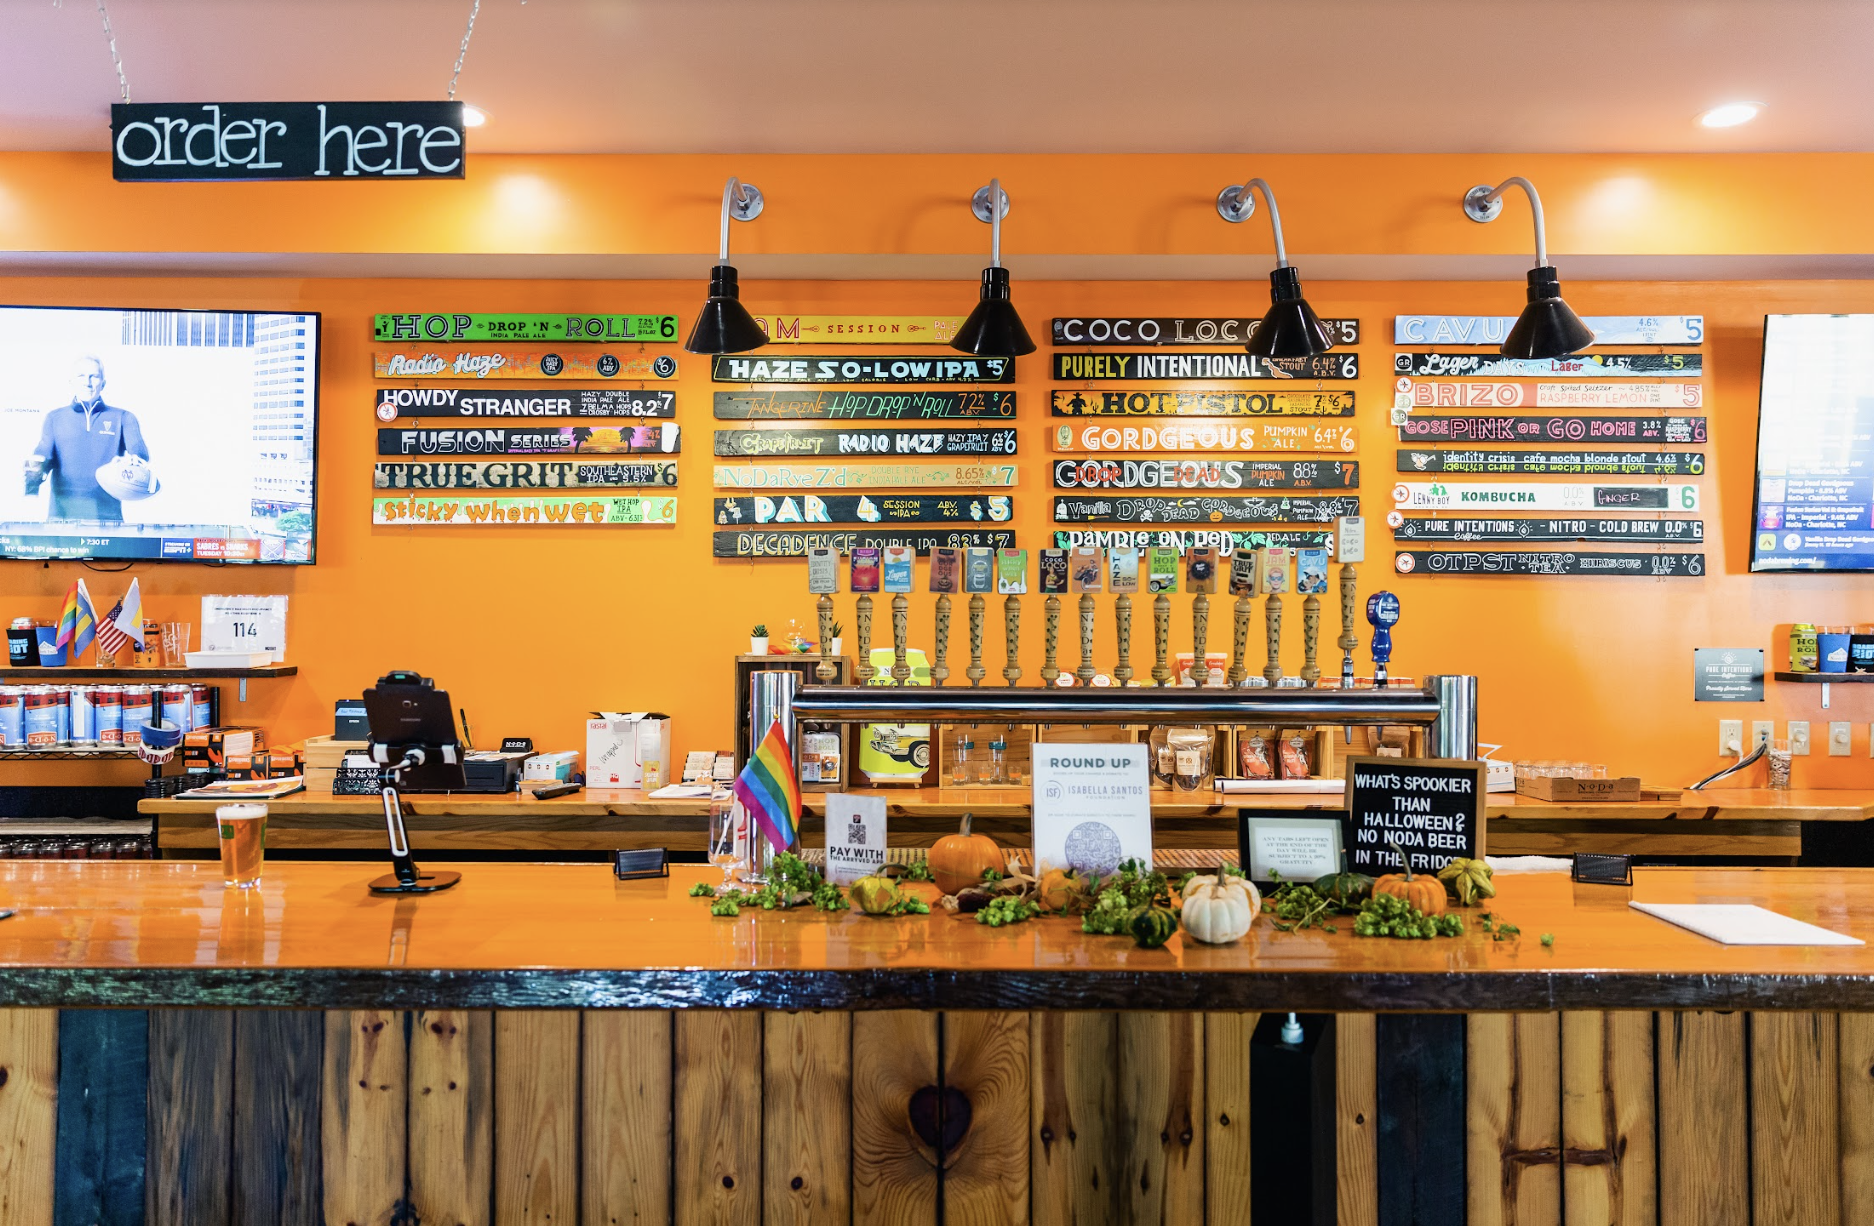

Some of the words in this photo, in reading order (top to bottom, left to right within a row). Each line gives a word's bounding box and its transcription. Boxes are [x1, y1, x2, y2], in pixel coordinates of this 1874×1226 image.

[116, 104, 287, 169] order
[314, 104, 461, 176] here
[392, 315, 473, 339] HOP
[488, 321, 527, 332] DROP
[565, 317, 636, 338] ROLL
[827, 324, 901, 334] SESSION
[933, 320, 958, 330] PALE
[1638, 317, 1659, 327] 4.6%
[1063, 319, 1161, 342] COCO
[1402, 317, 1504, 343] CAVU
[387, 352, 448, 376] Radio
[452, 351, 506, 378] Haze
[728, 359, 808, 379] HAZE
[935, 360, 980, 378] IPA
[1061, 355, 1131, 378] PURELY
[1137, 355, 1262, 378] INTENTIONAL
[1279, 361, 1306, 371] STOUT
[1418, 353, 1480, 375] Lager
[1482, 360, 1525, 376] DAYS
[1551, 359, 1584, 372] Lager
[1414, 383, 1519, 406] BRIZO
[1540, 392, 1602, 404] RASPBERRY
[1605, 393, 1647, 404] LEMON
[383, 389, 459, 406] HOWDY
[459, 398, 572, 416] STRANGER
[732, 390, 828, 419] TANGERINE
[1101, 392, 1173, 414] HOT
[1175, 392, 1284, 414] PISTOL
[1263, 425, 1308, 437] PUMPKIN
[1405, 420, 1449, 435] GOSE
[1450, 418, 1515, 440] PINK
[1517, 422, 1540, 435] OR
[1546, 417, 1586, 440] GO
[1590, 420, 1637, 436] HOME
[1642, 421, 1662, 430] 3.8%
[401, 430, 506, 454] FUSION
[510, 434, 573, 448] SERIES
[838, 434, 891, 453] RADIO
[895, 434, 946, 453] HAZE
[947, 433, 965, 443] HAZY
[1081, 426, 1256, 451] GORDGEOUS
[1273, 438, 1296, 449] ALE
[946, 442, 989, 452] GRAPEFRUIT
[1442, 450, 1485, 463] identity
[1487, 451, 1516, 463] crisis
[1523, 452, 1547, 463] cafe
[1549, 452, 1581, 464] mocha
[1583, 453, 1620, 464] blonde
[1621, 453, 1647, 464] stout
[580, 465, 654, 477] SOUTHEASTERN
[871, 466, 901, 475] DOUBLE
[904, 466, 920, 475] RYE
[1055, 460, 1245, 488] GORDGEOUS
[1252, 463, 1282, 471] IMPERIAL
[380, 463, 478, 489] TRUE
[482, 462, 573, 488] GRIT
[586, 475, 606, 484] IPA
[622, 475, 647, 483] 5.5%
[1074, 466, 1123, 483] DROP
[1172, 466, 1221, 483] DEAD
[1251, 470, 1286, 480] PUMPKIN
[1258, 479, 1275, 487] ALE
[883, 500, 920, 509] SESSION
[1413, 492, 1435, 505] LENNY
[1437, 496, 1450, 505] BOY
[1461, 491, 1537, 503] KOMBUCHA
[754, 495, 833, 523] PAR
[856, 495, 882, 523] 4
[942, 508, 959, 517] 4%
[1068, 500, 1112, 519] Vanilla
[1115, 497, 1166, 521] DROP
[1161, 506, 1200, 522] DEAD
[1424, 520, 1450, 532] PURE
[1453, 520, 1516, 533] INTENTIONS
[1549, 520, 1588, 533] NITRO
[1598, 521, 1629, 533] COLD
[1631, 521, 1660, 534] BREW
[1282, 533, 1301, 542] ALE
[1453, 533, 1483, 541] Coffee
[196, 542, 219, 551] SABRES
[736, 533, 858, 556] DECADENCE
[1153, 556, 1176, 565] HOP
[1265, 556, 1287, 565] JAM
[1427, 552, 1518, 572] OTPST
[1517, 553, 1576, 564] NITRO
[1579, 557, 1643, 569] HIBISCUS
[1528, 562, 1567, 574] TEA
[233, 622, 257, 637] 114
[1050, 757, 1106, 769] ROUND
[1110, 758, 1132, 769] UP
[1068, 785, 1108, 795] ISABELLA
[1110, 786, 1143, 795] SANTOS
[1355, 773, 1401, 790] WHAT'S
[1403, 776, 1472, 794] SPOOKIER
[1391, 796, 1431, 812] THAN
[1357, 828, 1378, 844] NO
[1383, 829, 1425, 847] NODA
[1427, 833, 1467, 850] BEER
[829, 846, 851, 857] PAY
[853, 847, 884, 860] WITH
[1355, 849, 1371, 865] IN
[1375, 850, 1405, 867] THE
